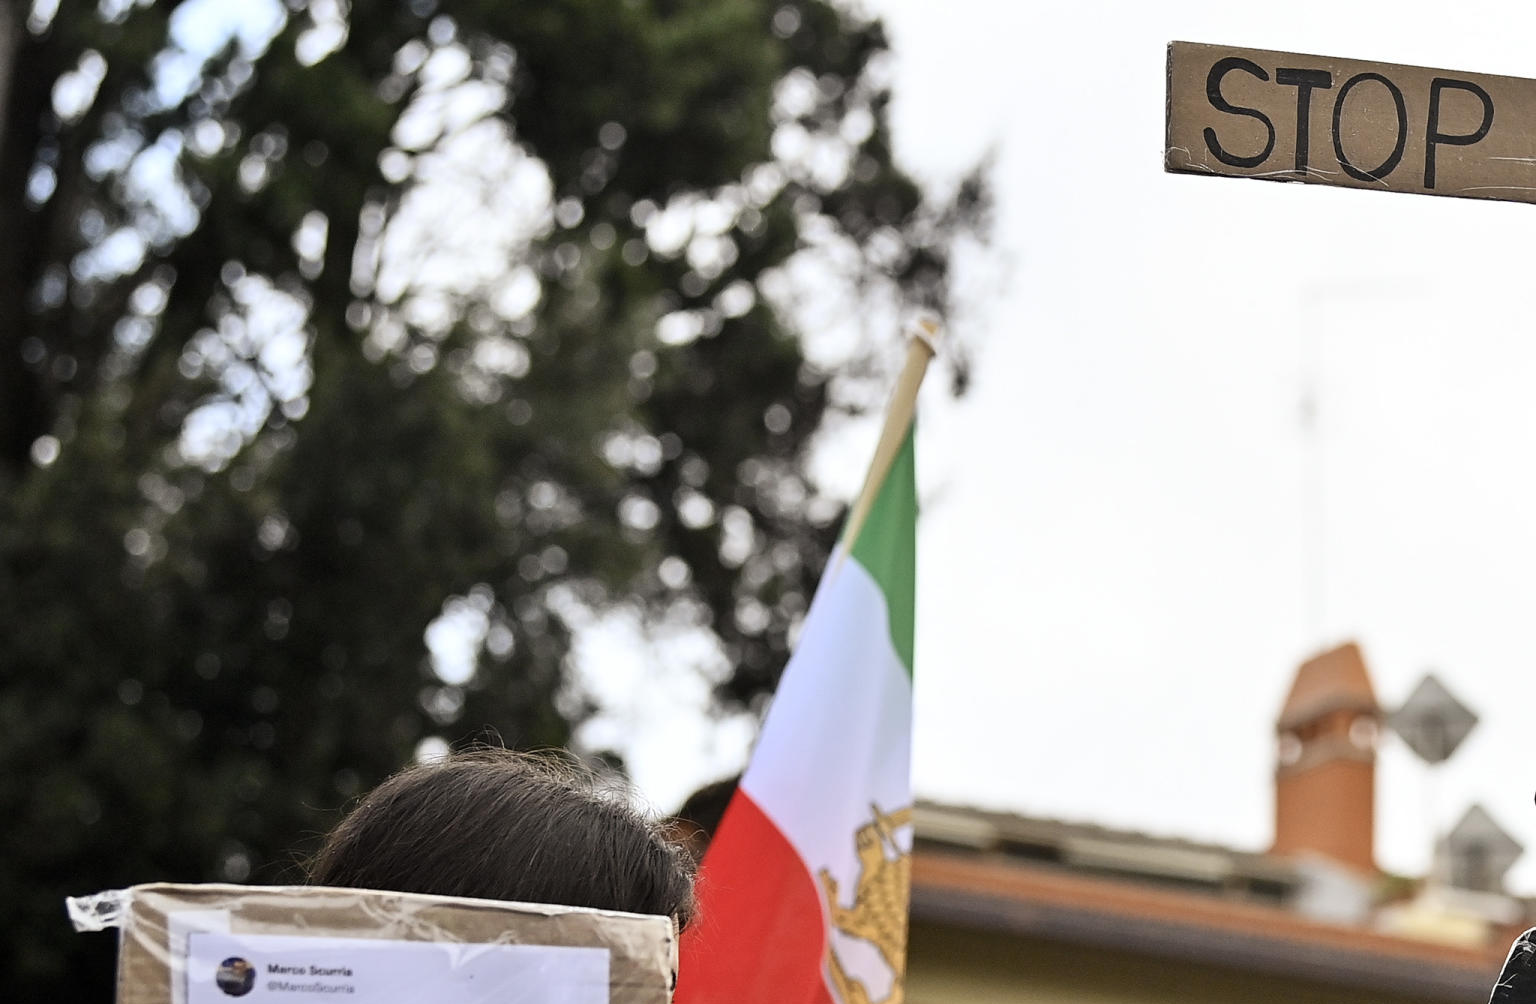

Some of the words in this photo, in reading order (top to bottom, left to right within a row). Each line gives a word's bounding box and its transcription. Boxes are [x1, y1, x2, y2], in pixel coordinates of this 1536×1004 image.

[1203, 56, 1495, 190] STOP
[267, 963, 306, 976] Marco
[309, 965, 353, 977] Scurria
